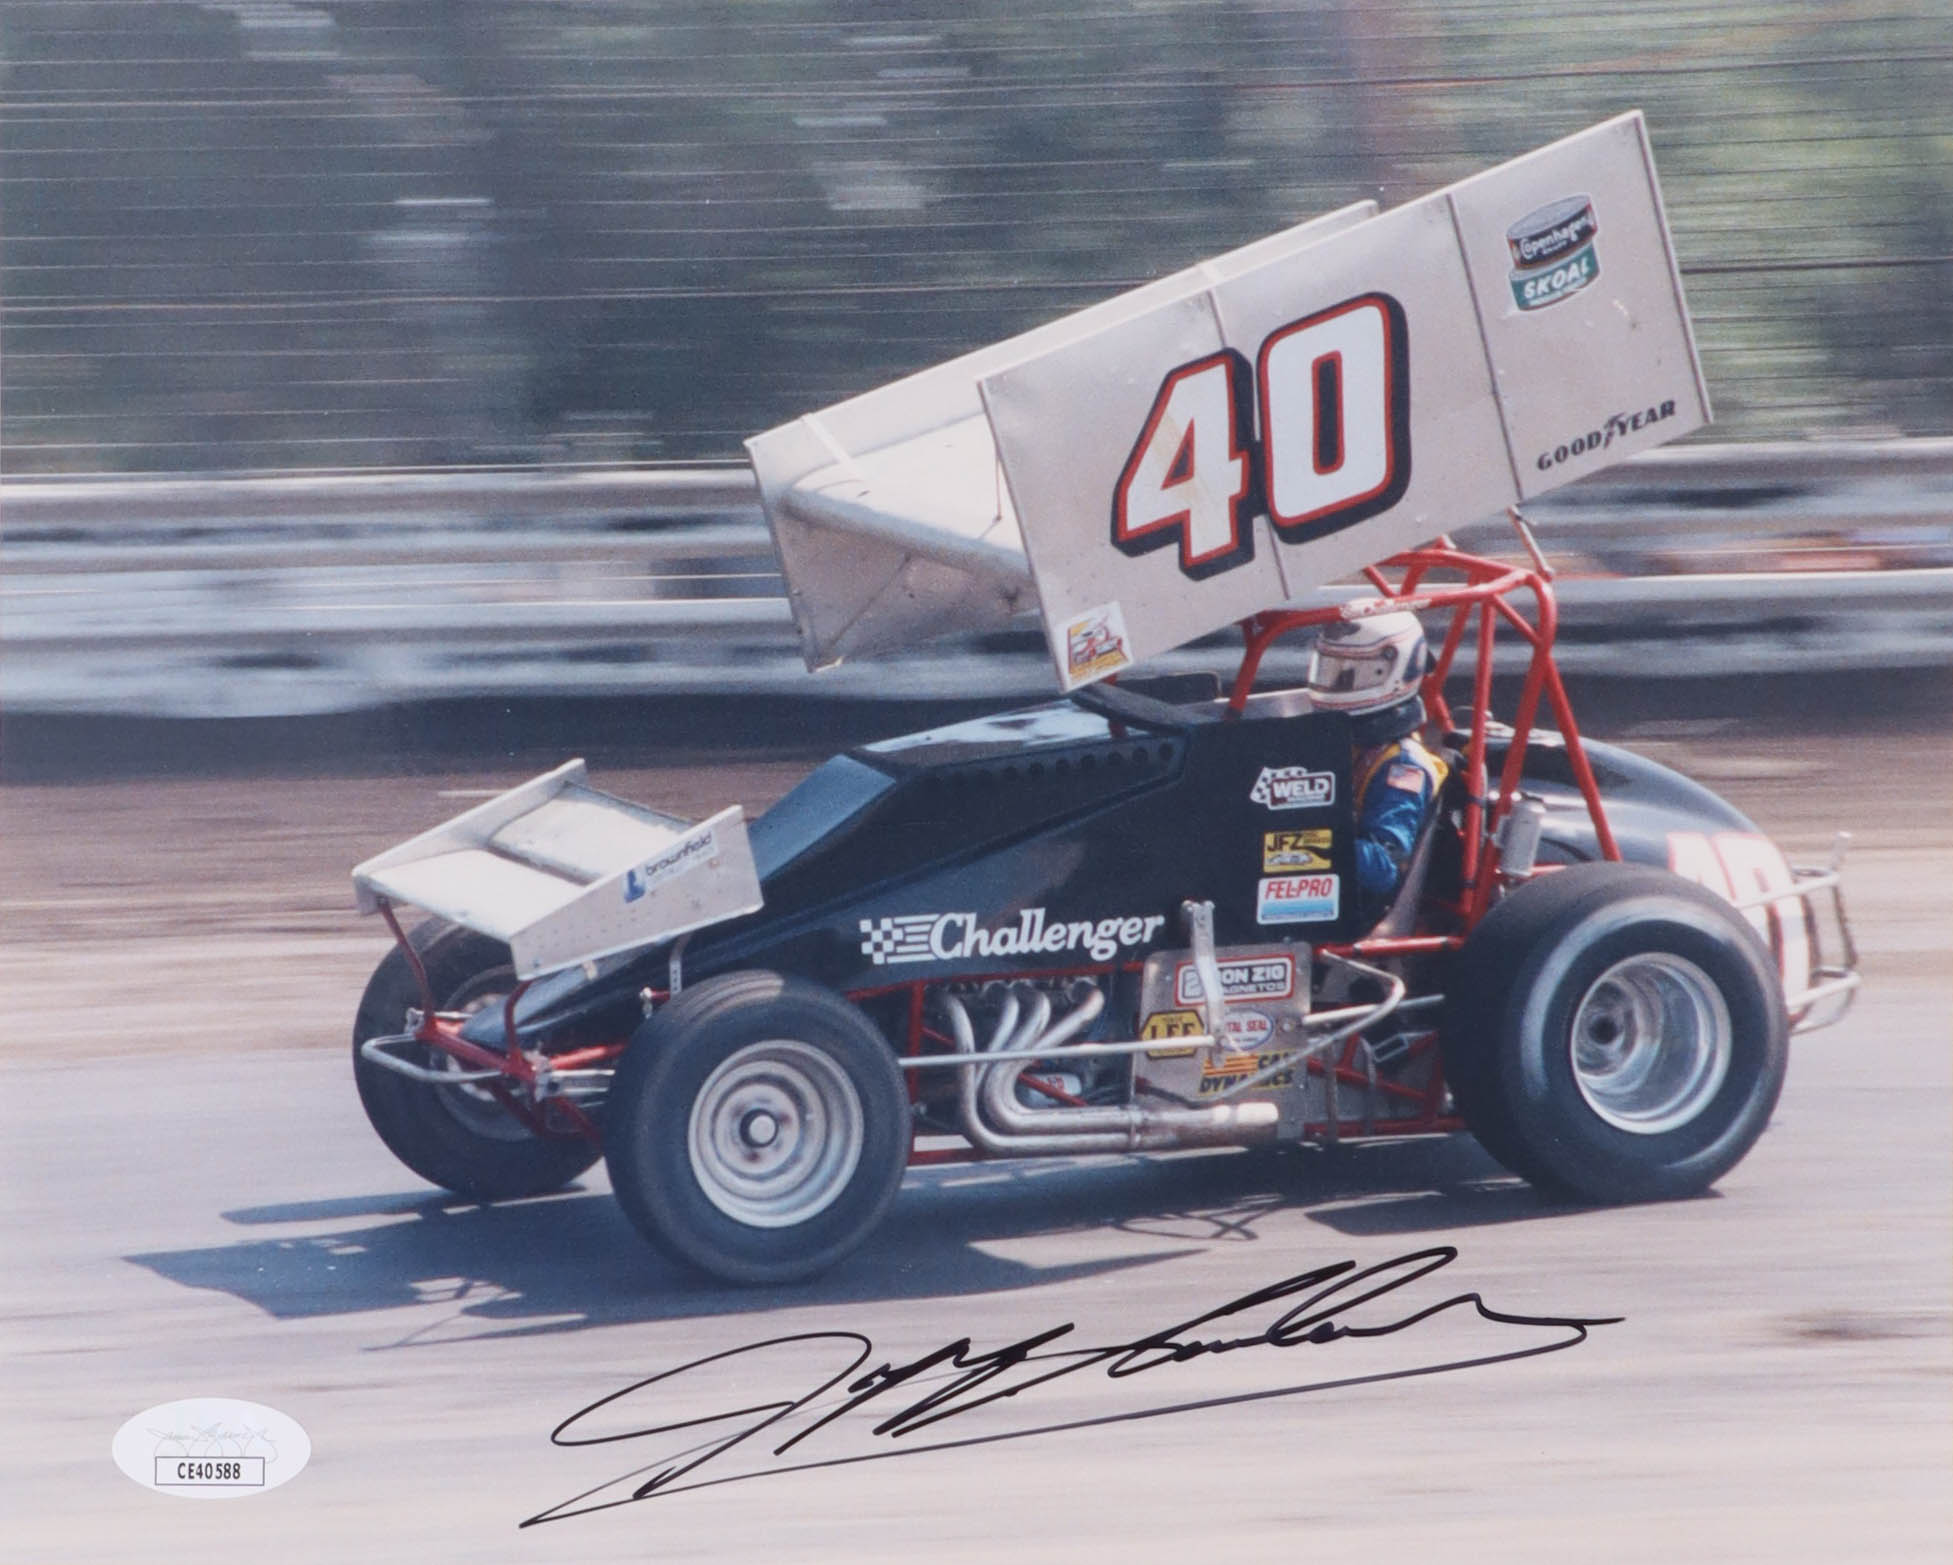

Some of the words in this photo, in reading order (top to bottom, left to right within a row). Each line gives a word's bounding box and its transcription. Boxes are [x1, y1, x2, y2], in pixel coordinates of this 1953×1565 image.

[1524, 256, 1590, 299] SKOAL
[1110, 291, 1412, 581] 40
[1537, 400, 1676, 471] GOODYEAR
[1272, 778, 1329, 799] WELD
[1267, 831, 1305, 852] JFZ
[930, 907, 1165, 961] Challenger
[1219, 967, 1250, 986] ON
[177, 1462, 241, 1480] CE40588
